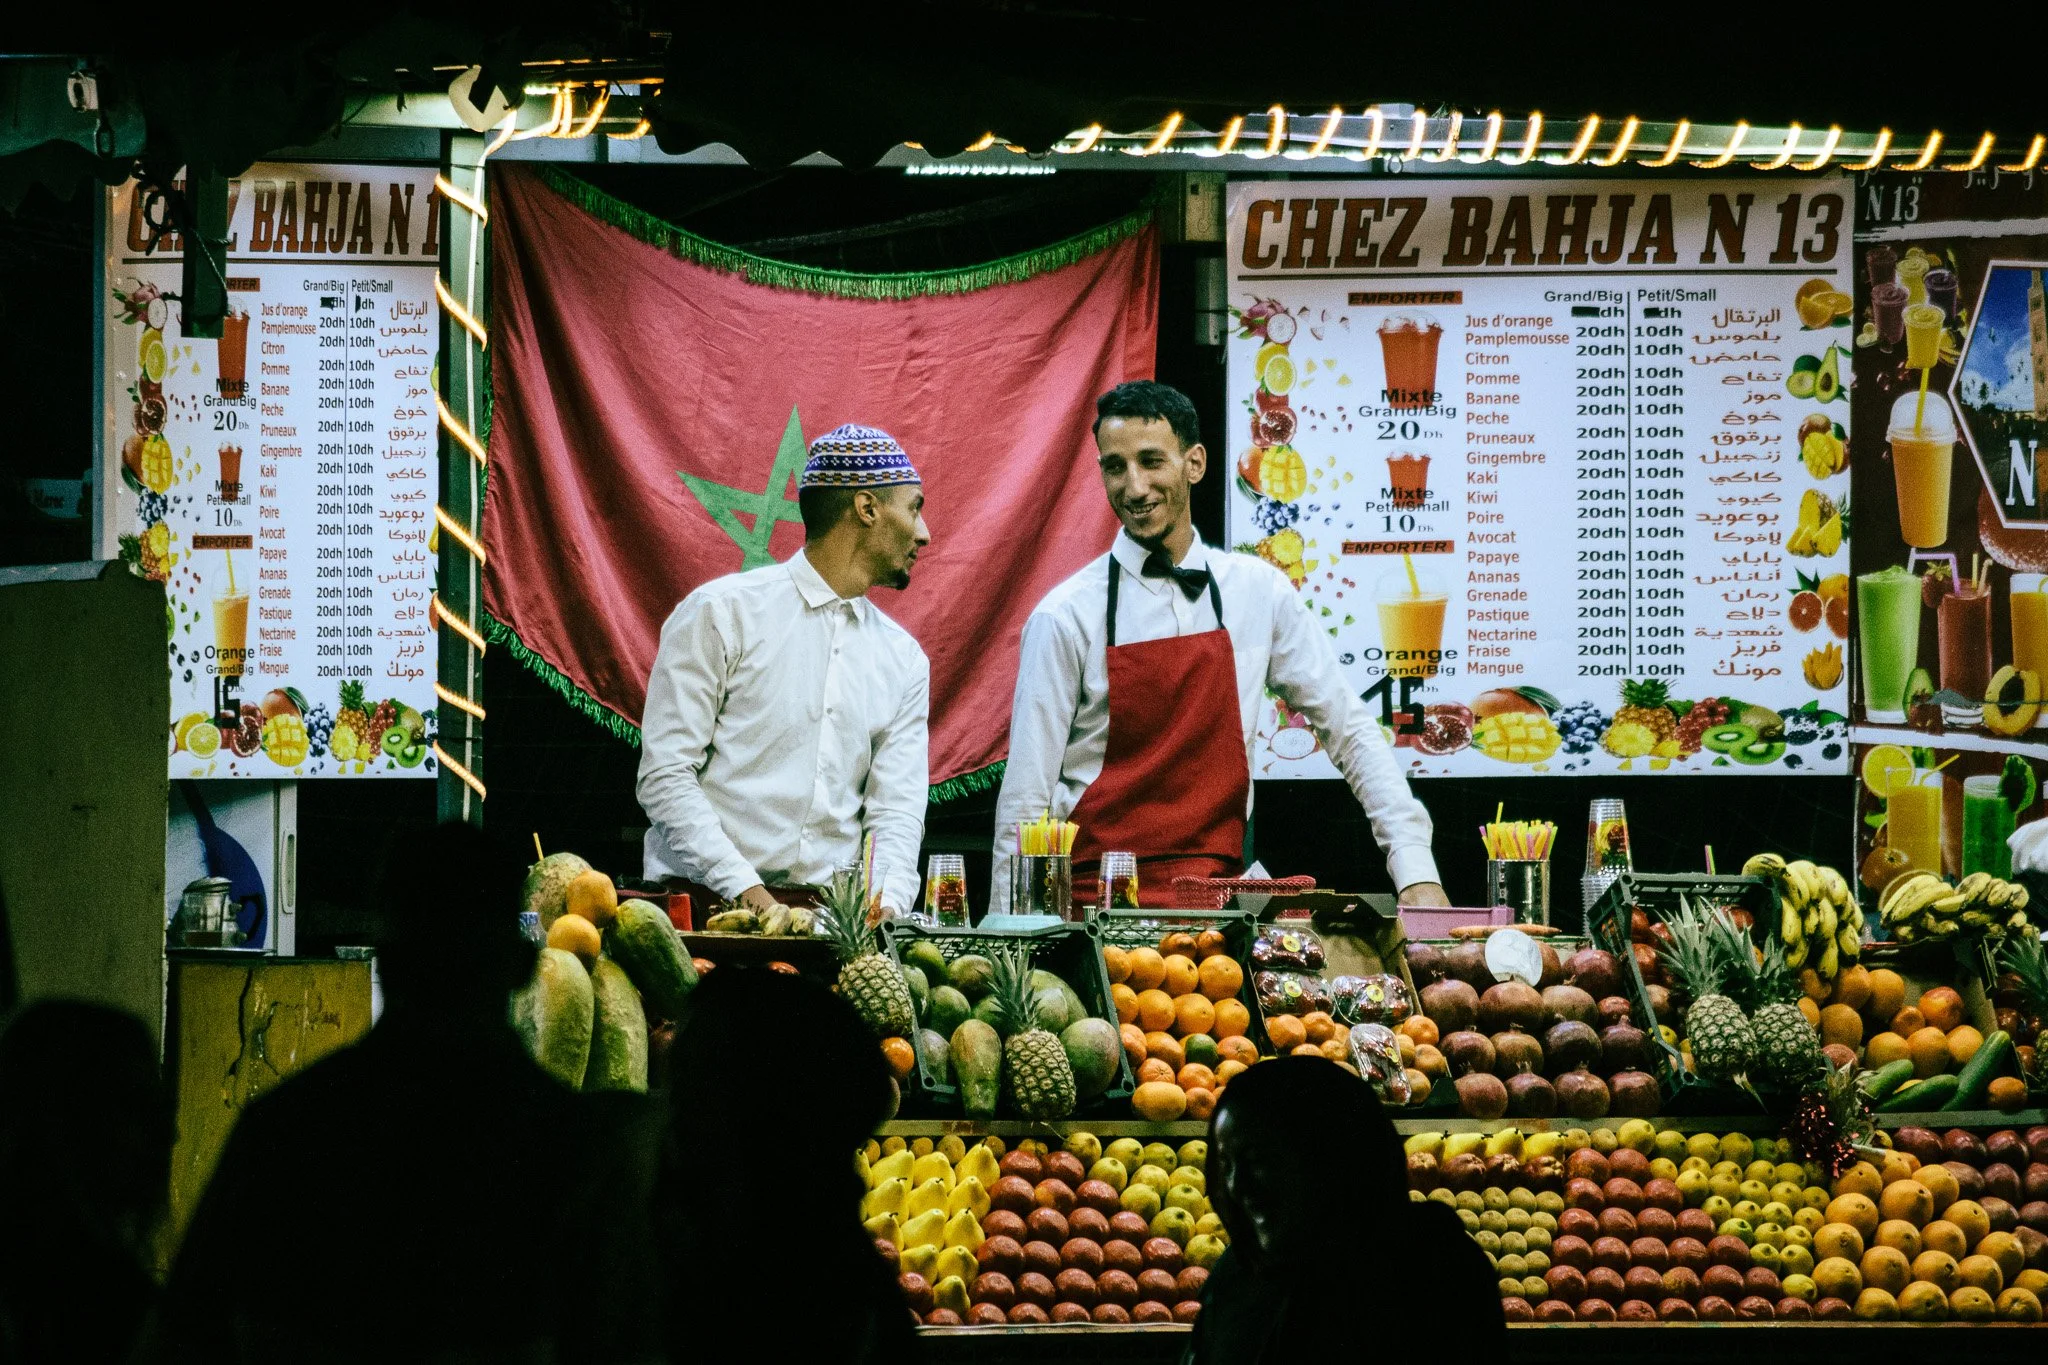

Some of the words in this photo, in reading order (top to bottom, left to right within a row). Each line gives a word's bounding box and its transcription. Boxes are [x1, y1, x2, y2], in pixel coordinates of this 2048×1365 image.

[1865, 185, 1884, 221] N
[1891, 186, 1920, 222] 13
[250, 181, 373, 253] BAHJA
[383, 183, 414, 255] N
[1242, 197, 1428, 270] CHEZ
[1442, 194, 1678, 266] BAHJA
[1699, 194, 1754, 265] N
[1770, 193, 1845, 264] 13
[303, 280, 344, 294] Grand/Big
[352, 279, 393, 292] Petit/Small
[1349, 292, 1455, 304] EMPORTER
[1544, 290, 1623, 304] Grand/Big
[1638, 288, 1716, 302] Petit/Small
[261, 303, 274, 316] Jus
[319, 317, 345, 328] 20dh
[1465, 315, 1488, 327] Jus
[1712, 308, 1780, 328] البرتقال
[261, 321, 316, 337] Pamplemousse
[1576, 326, 1625, 337] 20dh
[1635, 325, 1683, 337] 10dh
[319, 336, 345, 347] 20dh
[1466, 332, 1569, 347] Pamplemousse
[261, 341, 285, 354] Citron
[1576, 344, 1625, 356] 20dh
[1635, 343, 1683, 355] 10dh
[1465, 352, 1509, 365] Citron
[1689, 351, 1781, 365] حامض
[261, 362, 290, 375] Pomme
[319, 359, 345, 372] 20dh
[1466, 372, 1520, 385] Pomme
[1576, 367, 1625, 379] 20dh
[1635, 367, 1683, 378] 10dh
[1721, 371, 1782, 385] تفاح
[216, 378, 249, 392] Mixte
[261, 382, 289, 396] Banane
[319, 378, 344, 389] 20dh
[1380, 389, 1442, 403] Mixte
[1577, 385, 1625, 397] 20dh
[1635, 384, 1683, 396] 10dh
[203, 395, 256, 408] Grand/Big
[318, 397, 344, 408] 20dh
[1466, 392, 1520, 404] Banane
[1743, 390, 1781, 404] موز
[261, 403, 284, 416] Peche
[1359, 406, 1457, 419] Grand/Big
[1577, 404, 1625, 415] 20dh
[1635, 403, 1683, 415] 10dh
[213, 411, 237, 431] 20
[1466, 411, 1509, 424] Peche
[1722, 411, 1781, 425] خوخ
[261, 423, 296, 437] Pruneaux
[318, 420, 344, 433] 20dh
[1377, 421, 1420, 440] 20
[1577, 427, 1625, 438] 20dh
[1635, 426, 1684, 438] 10dh
[1467, 432, 1535, 444] Pruneaux
[1711, 431, 1781, 446] برقوق
[261, 444, 302, 460] Gingembre
[318, 443, 343, 455] 20dh
[1577, 449, 1625, 460] 20dh
[1635, 448, 1684, 460] 10dh
[1466, 451, 1546, 467] Gingembre
[1699, 450, 1780, 464] زنجبيل
[260, 464, 277, 478] Kaki
[317, 462, 343, 474] 20dh
[1577, 467, 1626, 479] 20dh
[1635, 467, 1684, 478] 10dh
[2005, 438, 2037, 506] N
[1467, 471, 1498, 484] Kaki
[1709, 471, 1782, 485] كاكي
[215, 480, 243, 492] Mixte
[260, 485, 276, 498] Kiwi
[317, 484, 343, 496] 20dh
[1381, 488, 1434, 500] Mixte
[1467, 491, 1497, 503] Kiwi
[1577, 489, 1626, 500] 20dh
[1636, 488, 1684, 500] 10dh
[1717, 492, 1782, 506] كيوي
[260, 505, 279, 518] Poire
[317, 503, 343, 516] 20dh
[1366, 501, 1450, 512] Petit/Small
[1636, 506, 1684, 518] 10dh
[214, 508, 233, 526] 10
[1467, 511, 1504, 523] Poire
[1577, 507, 1626, 519] 20dh
[317, 523, 343, 536] 20dh
[1381, 515, 1416, 533] 10
[260, 526, 285, 539] Avocat
[1467, 531, 1516, 543] Avocat
[1577, 527, 1626, 539] 20dh
[1636, 526, 1684, 538] 10dh
[193, 537, 249, 548] EMPORTER
[1342, 542, 1448, 554] EMPORTER
[260, 547, 287, 562] Papaye
[317, 547, 342, 559] 20dh
[1468, 551, 1519, 566] Papaye
[1577, 550, 1626, 562] 20dh
[1636, 549, 1684, 561] 10dh
[259, 567, 287, 580] Ananas
[317, 566, 342, 578] 20dh
[1467, 571, 1520, 583] Ananas
[1578, 568, 1626, 580] 20dh
[1636, 568, 1684, 579] 10dh
[259, 586, 291, 599] Grenade
[317, 587, 342, 598] 20dh
[1467, 588, 1527, 601] Grenade
[1578, 588, 1626, 600] 20dh
[1636, 587, 1684, 599] 10dh
[1721, 588, 1779, 602] رمان
[259, 607, 292, 622] Pastique
[317, 605, 342, 617] 20dh
[1468, 608, 1529, 624] Pastique
[1578, 606, 1626, 618] 20dh
[1636, 605, 1684, 617] 10dh
[259, 627, 296, 640] Nectarine
[317, 626, 342, 638] 20dh
[1468, 628, 1537, 641] Nectarine
[1578, 626, 1626, 638] 20dh
[1636, 626, 1684, 637] 10dh
[205, 646, 255, 661] Orange
[260, 643, 282, 656] Fraise
[317, 644, 342, 656] 20dh
[1468, 644, 1510, 657] Fraise
[1578, 644, 1626, 656] 20dh
[1636, 643, 1685, 655] 10dh
[1731, 640, 1781, 658] فريز
[1364, 648, 1458, 663] Orange
[206, 664, 254, 675] Grand/Big
[259, 661, 289, 677] Mangue
[1366, 666, 1456, 678] Grand/Big
[1467, 662, 1523, 677] Mangue
[1578, 664, 1626, 676] 20dh
[1636, 664, 1685, 676] 10dh
